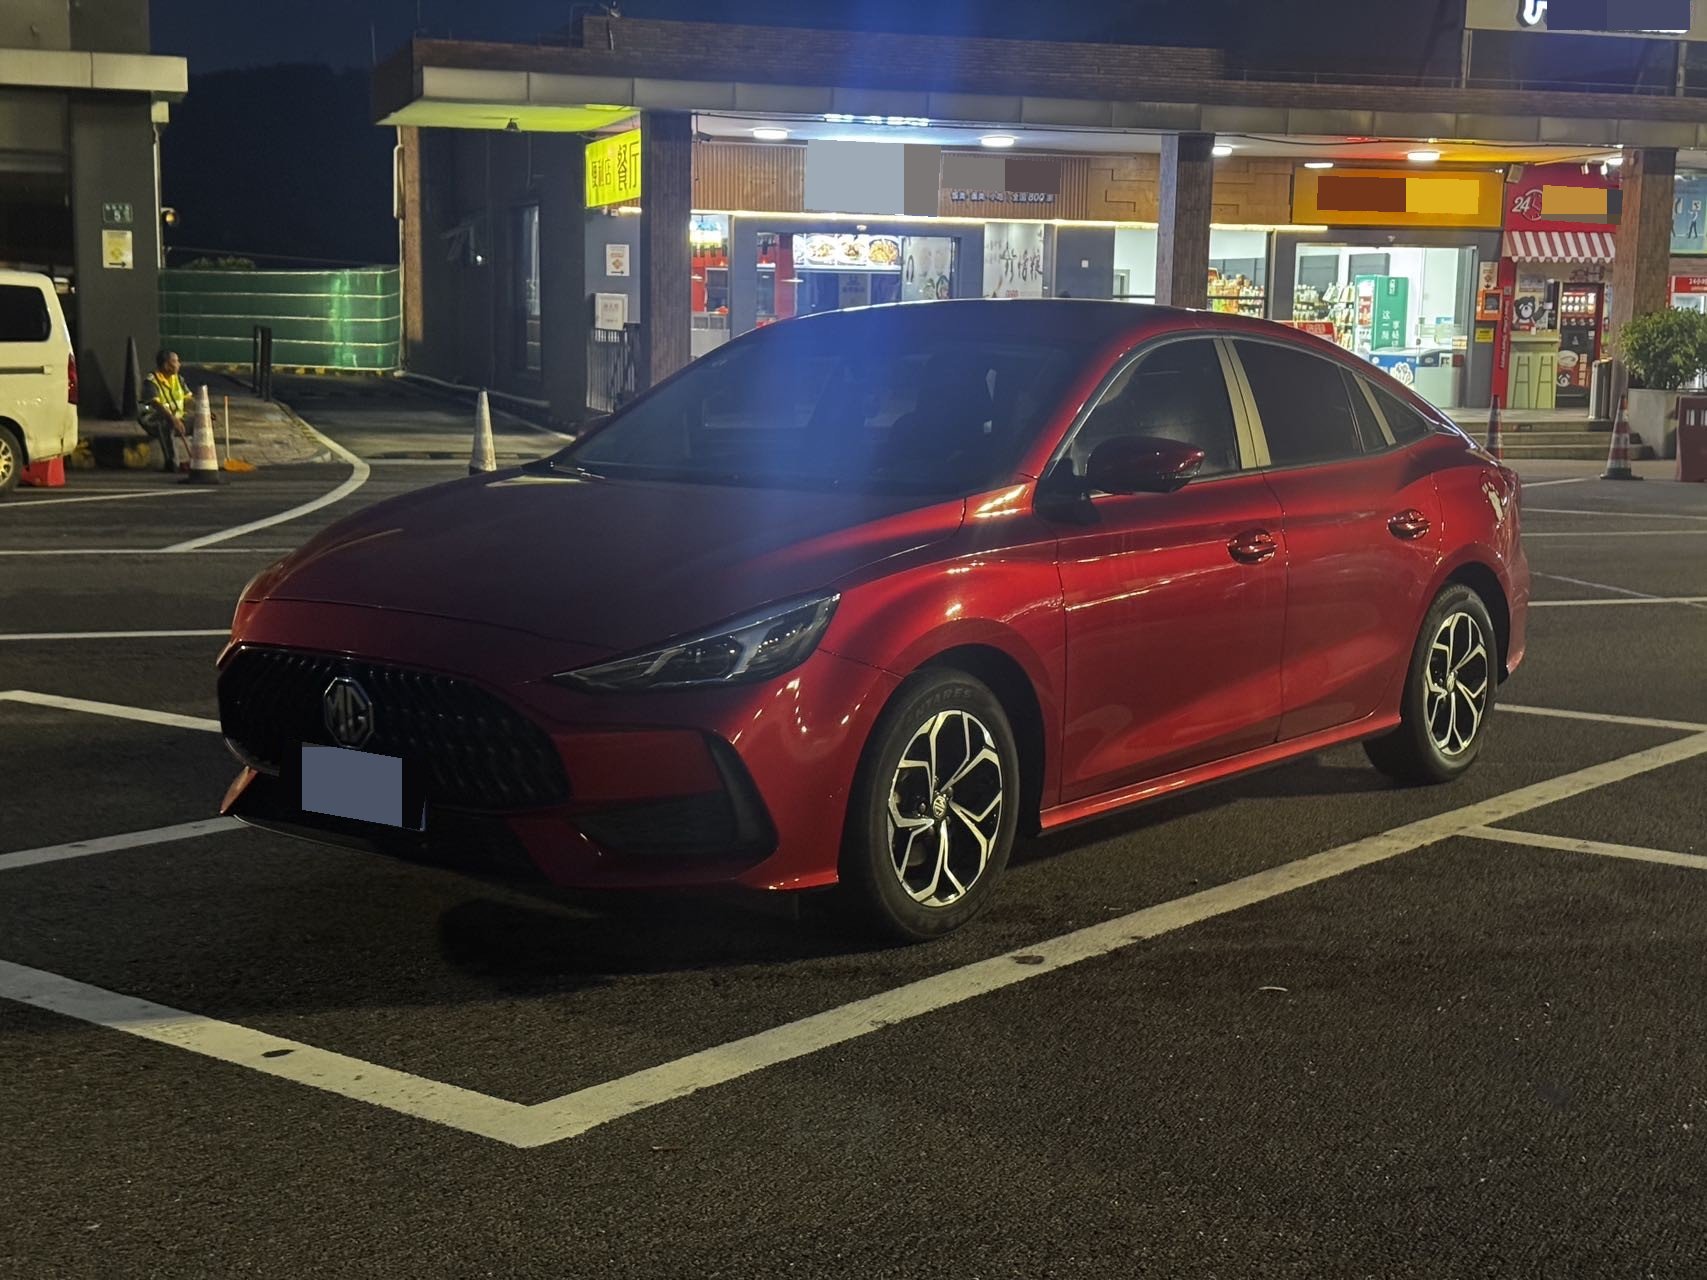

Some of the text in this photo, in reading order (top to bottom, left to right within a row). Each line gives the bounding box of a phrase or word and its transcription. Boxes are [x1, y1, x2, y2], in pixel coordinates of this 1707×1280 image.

[591, 141, 639, 192] 便利店 餐厅
[1511, 197, 1530, 213] 24
[326, 684, 368, 744] MG
